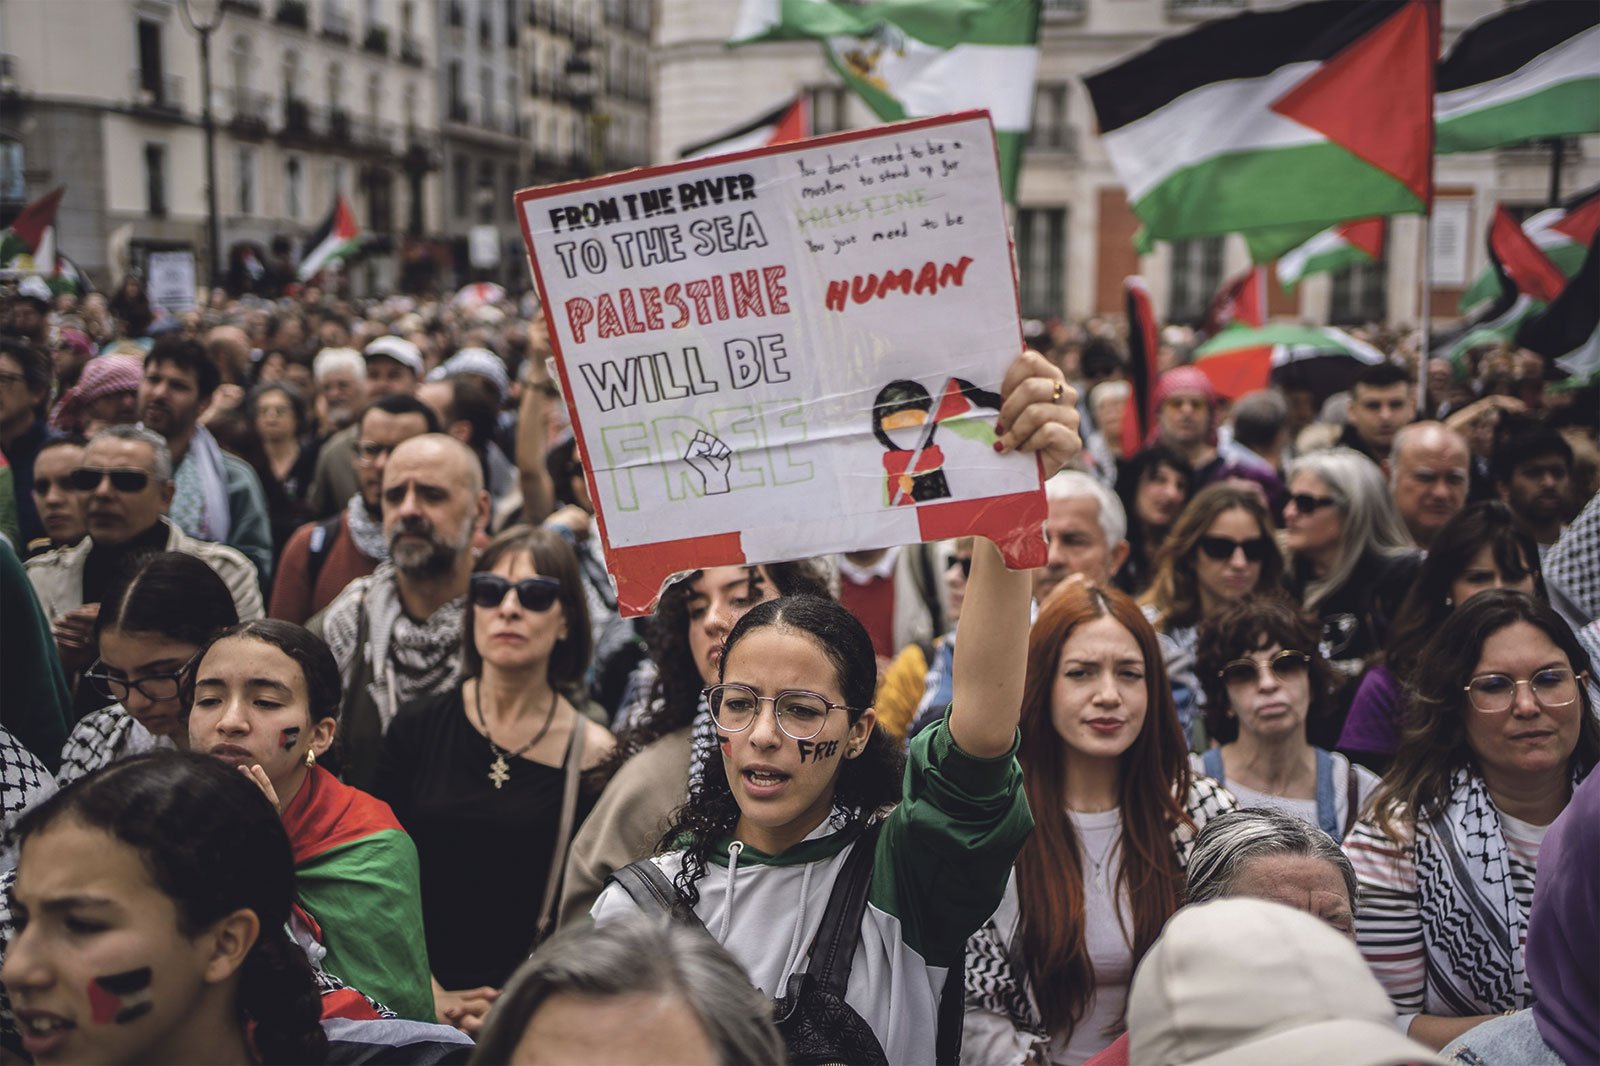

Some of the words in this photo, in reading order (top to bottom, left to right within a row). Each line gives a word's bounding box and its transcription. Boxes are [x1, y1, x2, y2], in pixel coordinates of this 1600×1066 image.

[827, 154, 861, 175] don't
[872, 142, 904, 165] need
[910, 146, 923, 159] to
[926, 139, 945, 155] be
[953, 142, 963, 150] a
[859, 175, 874, 186] to
[879, 164, 910, 183] stand
[549, 196, 621, 233] FROM
[623, 187, 676, 220] THE
[678, 173, 757, 211] RIVER
[555, 238, 607, 278] TO
[612, 224, 686, 269] THE
[689, 211, 768, 256] SEA
[833, 234, 857, 255] just
[872, 221, 908, 242] need
[921, 218, 939, 230] to
[946, 212, 965, 227] be
[565, 265, 790, 344] PALESTINE
[825, 256, 974, 312] HUMAN
[579, 346, 718, 412] WILL
[724, 334, 790, 389] BE
[601, 397, 814, 512] FREE
[797, 739, 839, 764] FREE
